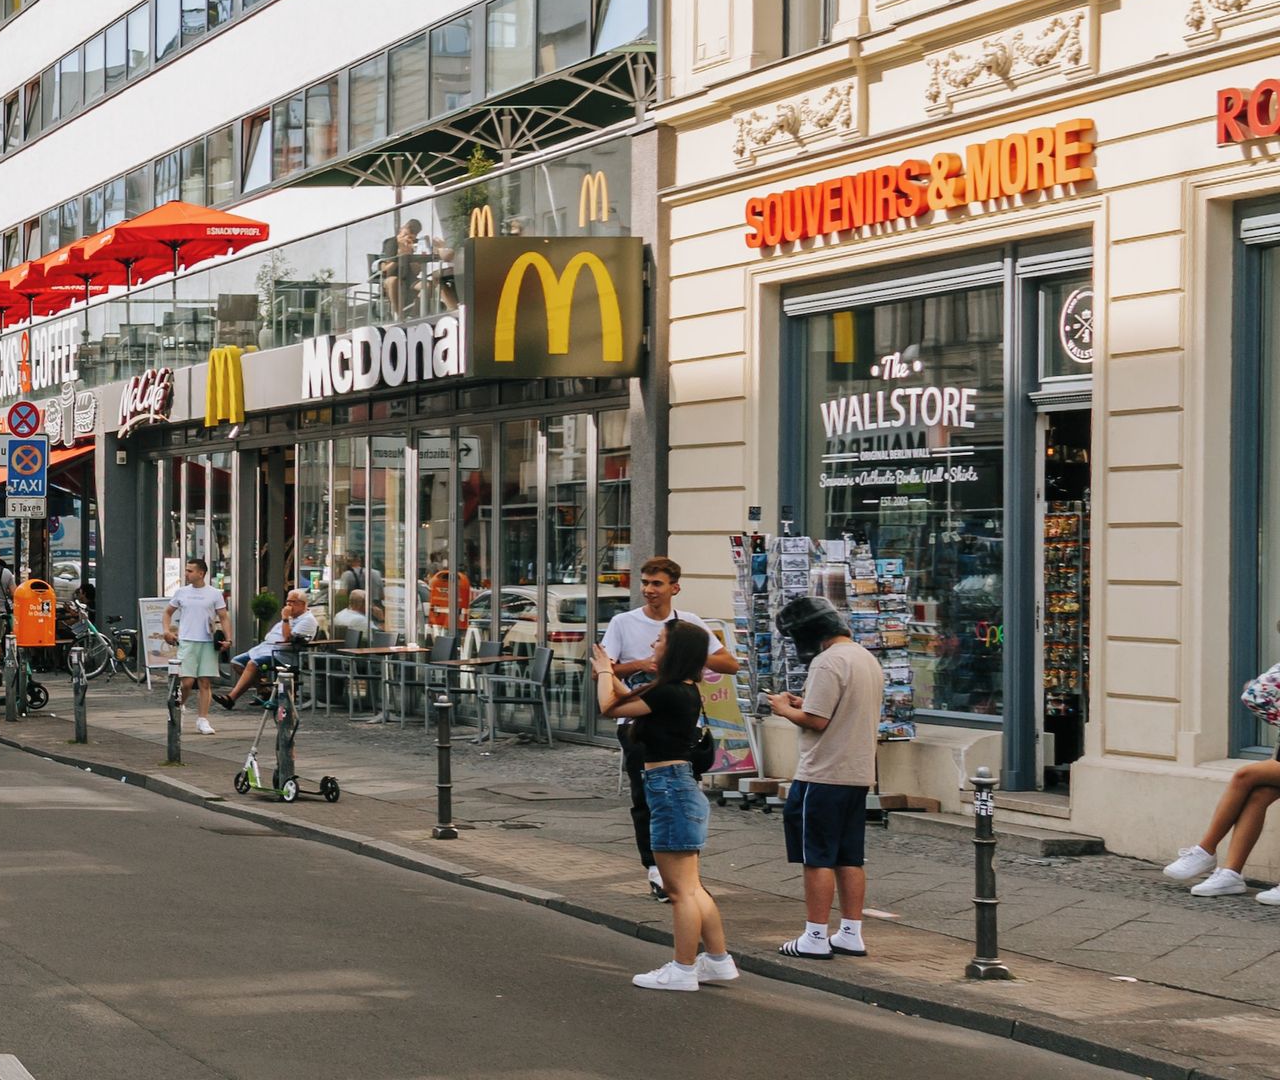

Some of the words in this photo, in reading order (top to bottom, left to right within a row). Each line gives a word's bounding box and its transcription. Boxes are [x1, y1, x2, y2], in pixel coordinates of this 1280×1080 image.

[745, 158, 931, 249] SOUVENIRS
[927, 152, 966, 211] &
[965, 118, 1096, 203] MORE
[19, 331, 31, 393] &
[31, 317, 80, 390] COFFEE
[301, 303, 466, 400] McDonal
[880, 351, 910, 381] The
[820, 386, 978, 438] WALLSTORE
[860, 450, 890, 461] ORIGINAL
[890, 448, 911, 460] BERLIN
[911, 448, 931, 459] WALL
[11, 479, 42, 492] TAXI
[819, 473, 856, 488] Souvenirs
[859, 470, 896, 486] Authentic
[895, 468, 921, 484] Berlin
[922, 466, 944, 484] Wall
[948, 465, 979, 483] Shirts
[11, 503, 16, 512] 5
[19, 503, 42, 512] Taxen
